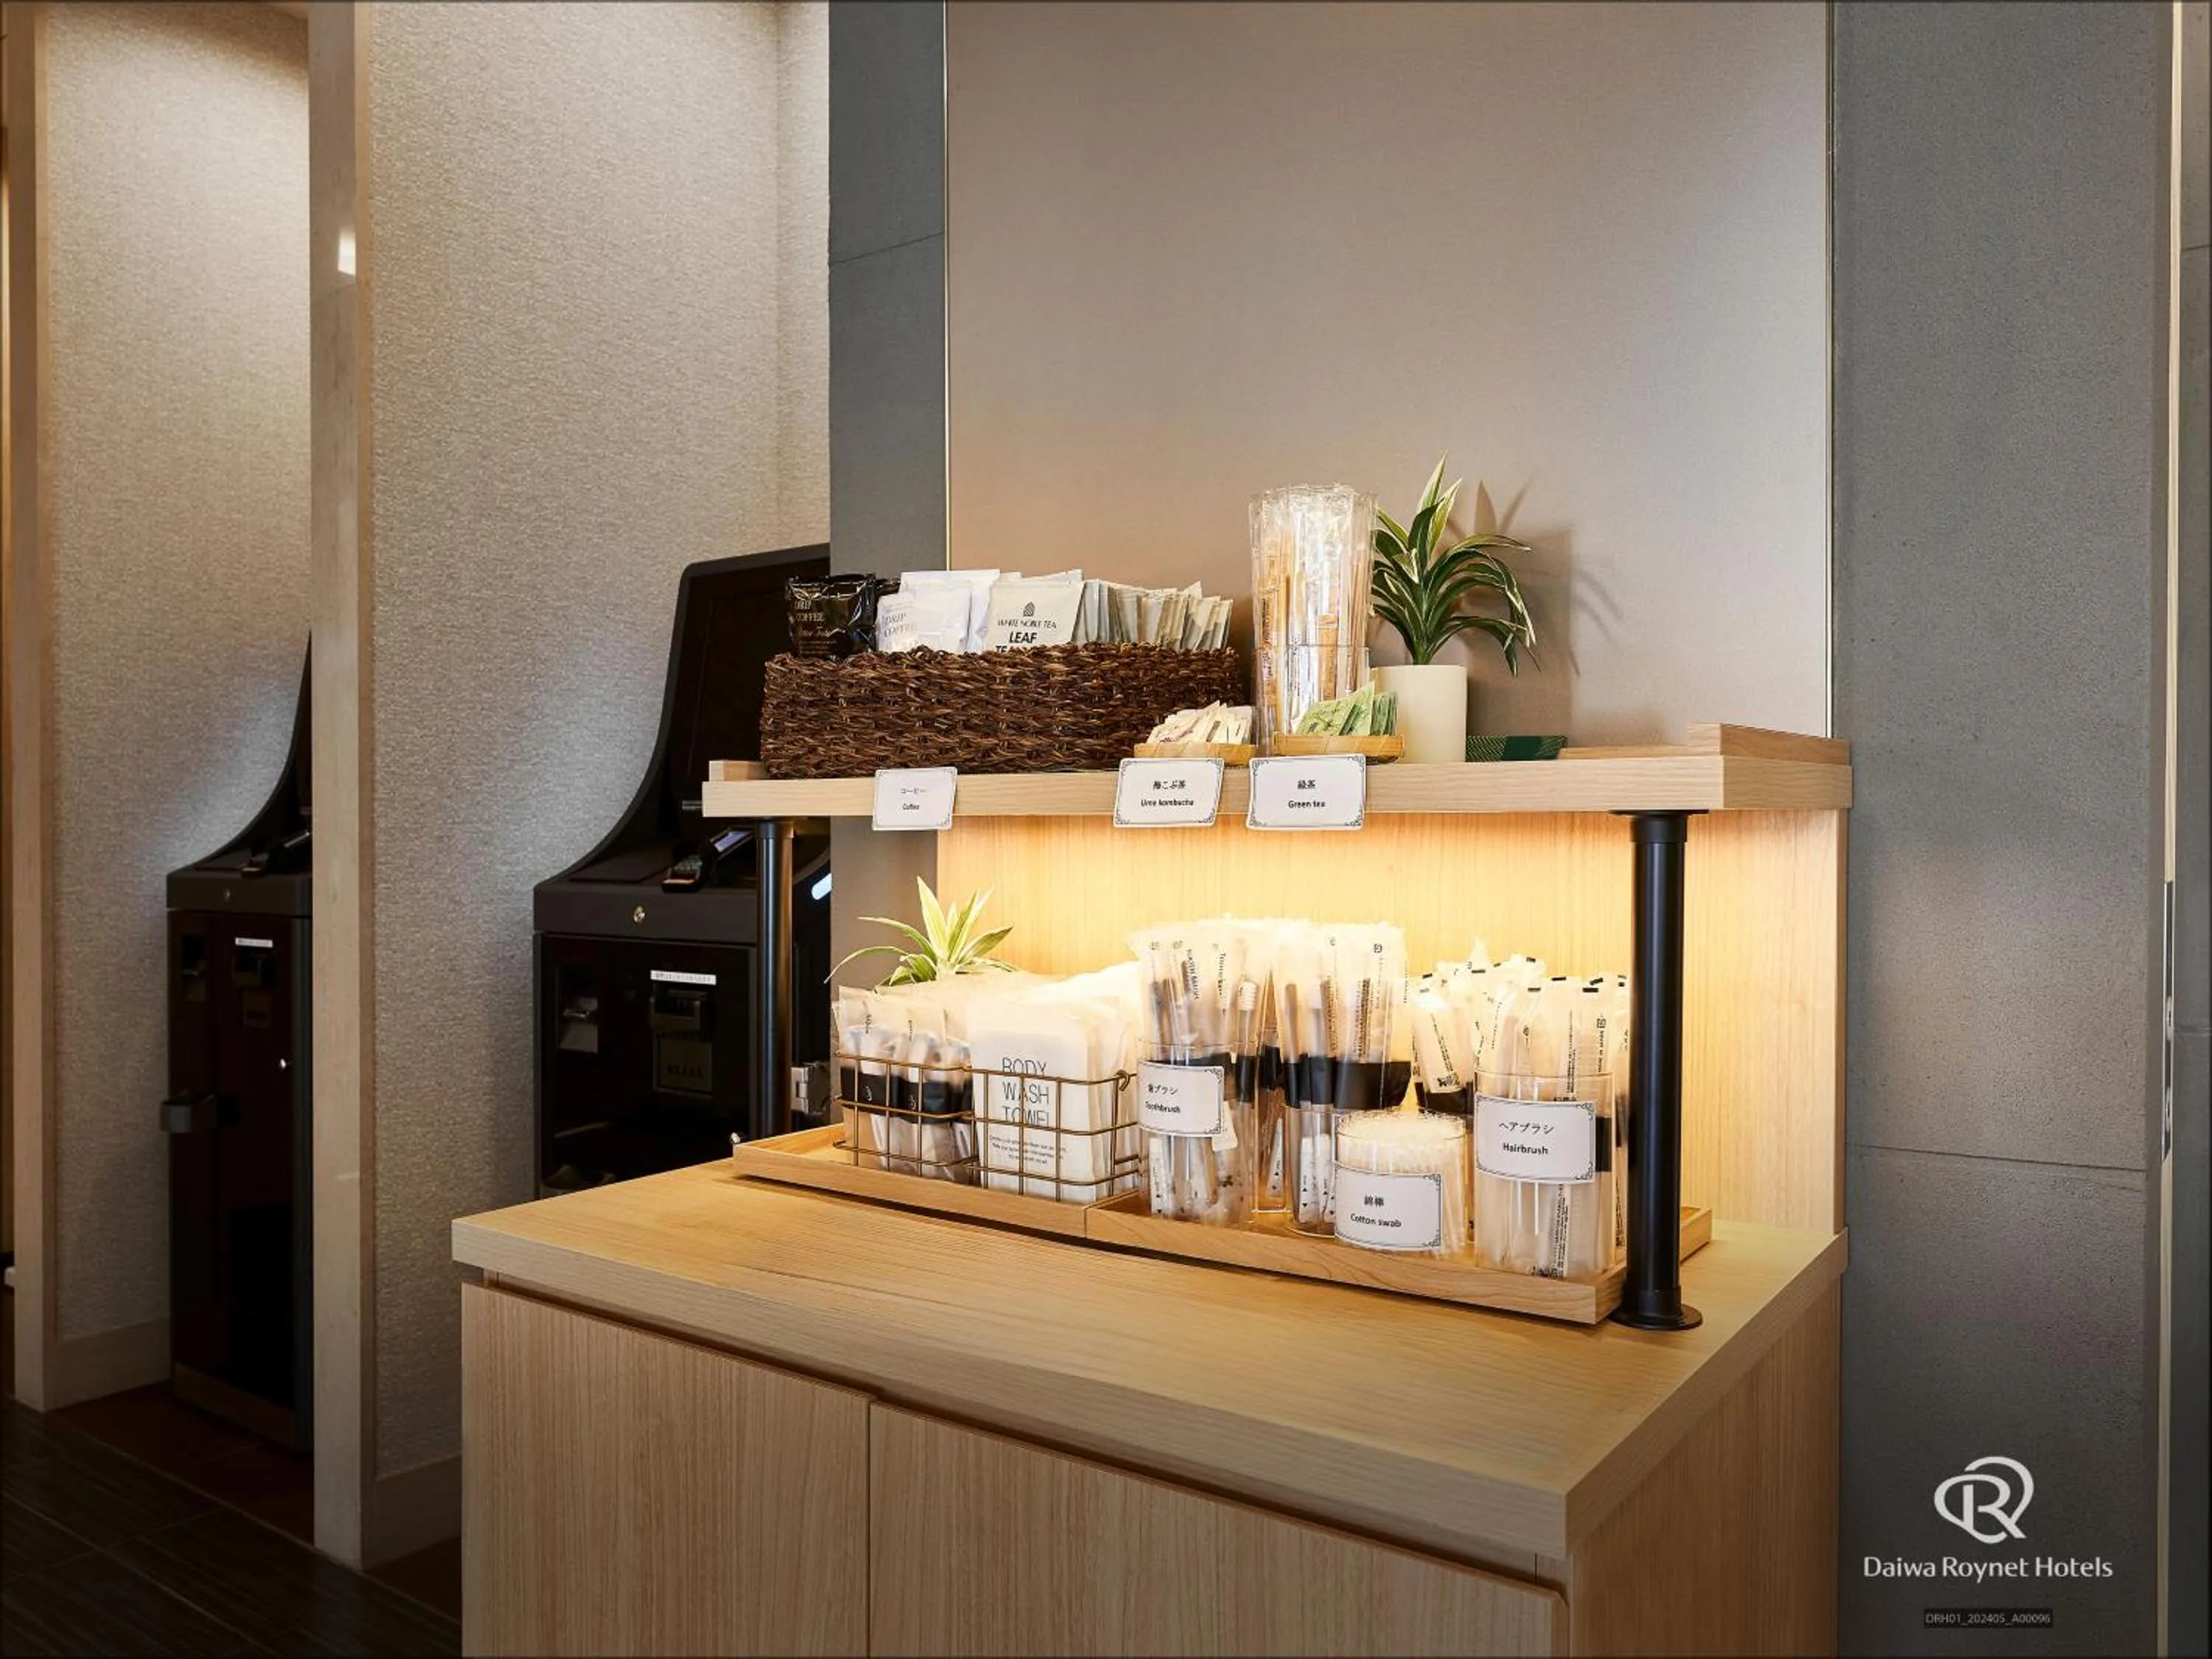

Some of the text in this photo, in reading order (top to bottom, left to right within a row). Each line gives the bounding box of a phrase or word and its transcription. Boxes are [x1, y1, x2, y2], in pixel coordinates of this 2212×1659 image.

[1043, 620, 1057, 629] TEA
[1009, 631, 1037, 644] LEAF
[1141, 799, 1194, 807] Ume kombucha
[1288, 800, 1326, 809] Green tea
[1002, 1057, 1048, 1076] BODY
[1003, 1081, 1049, 1105] WASH
[1499, 1121, 1554, 1135] ヘアブラシ
[1503, 1142, 1548, 1155] Hairbrush
[1350, 1213, 1402, 1228] Cotton swab
